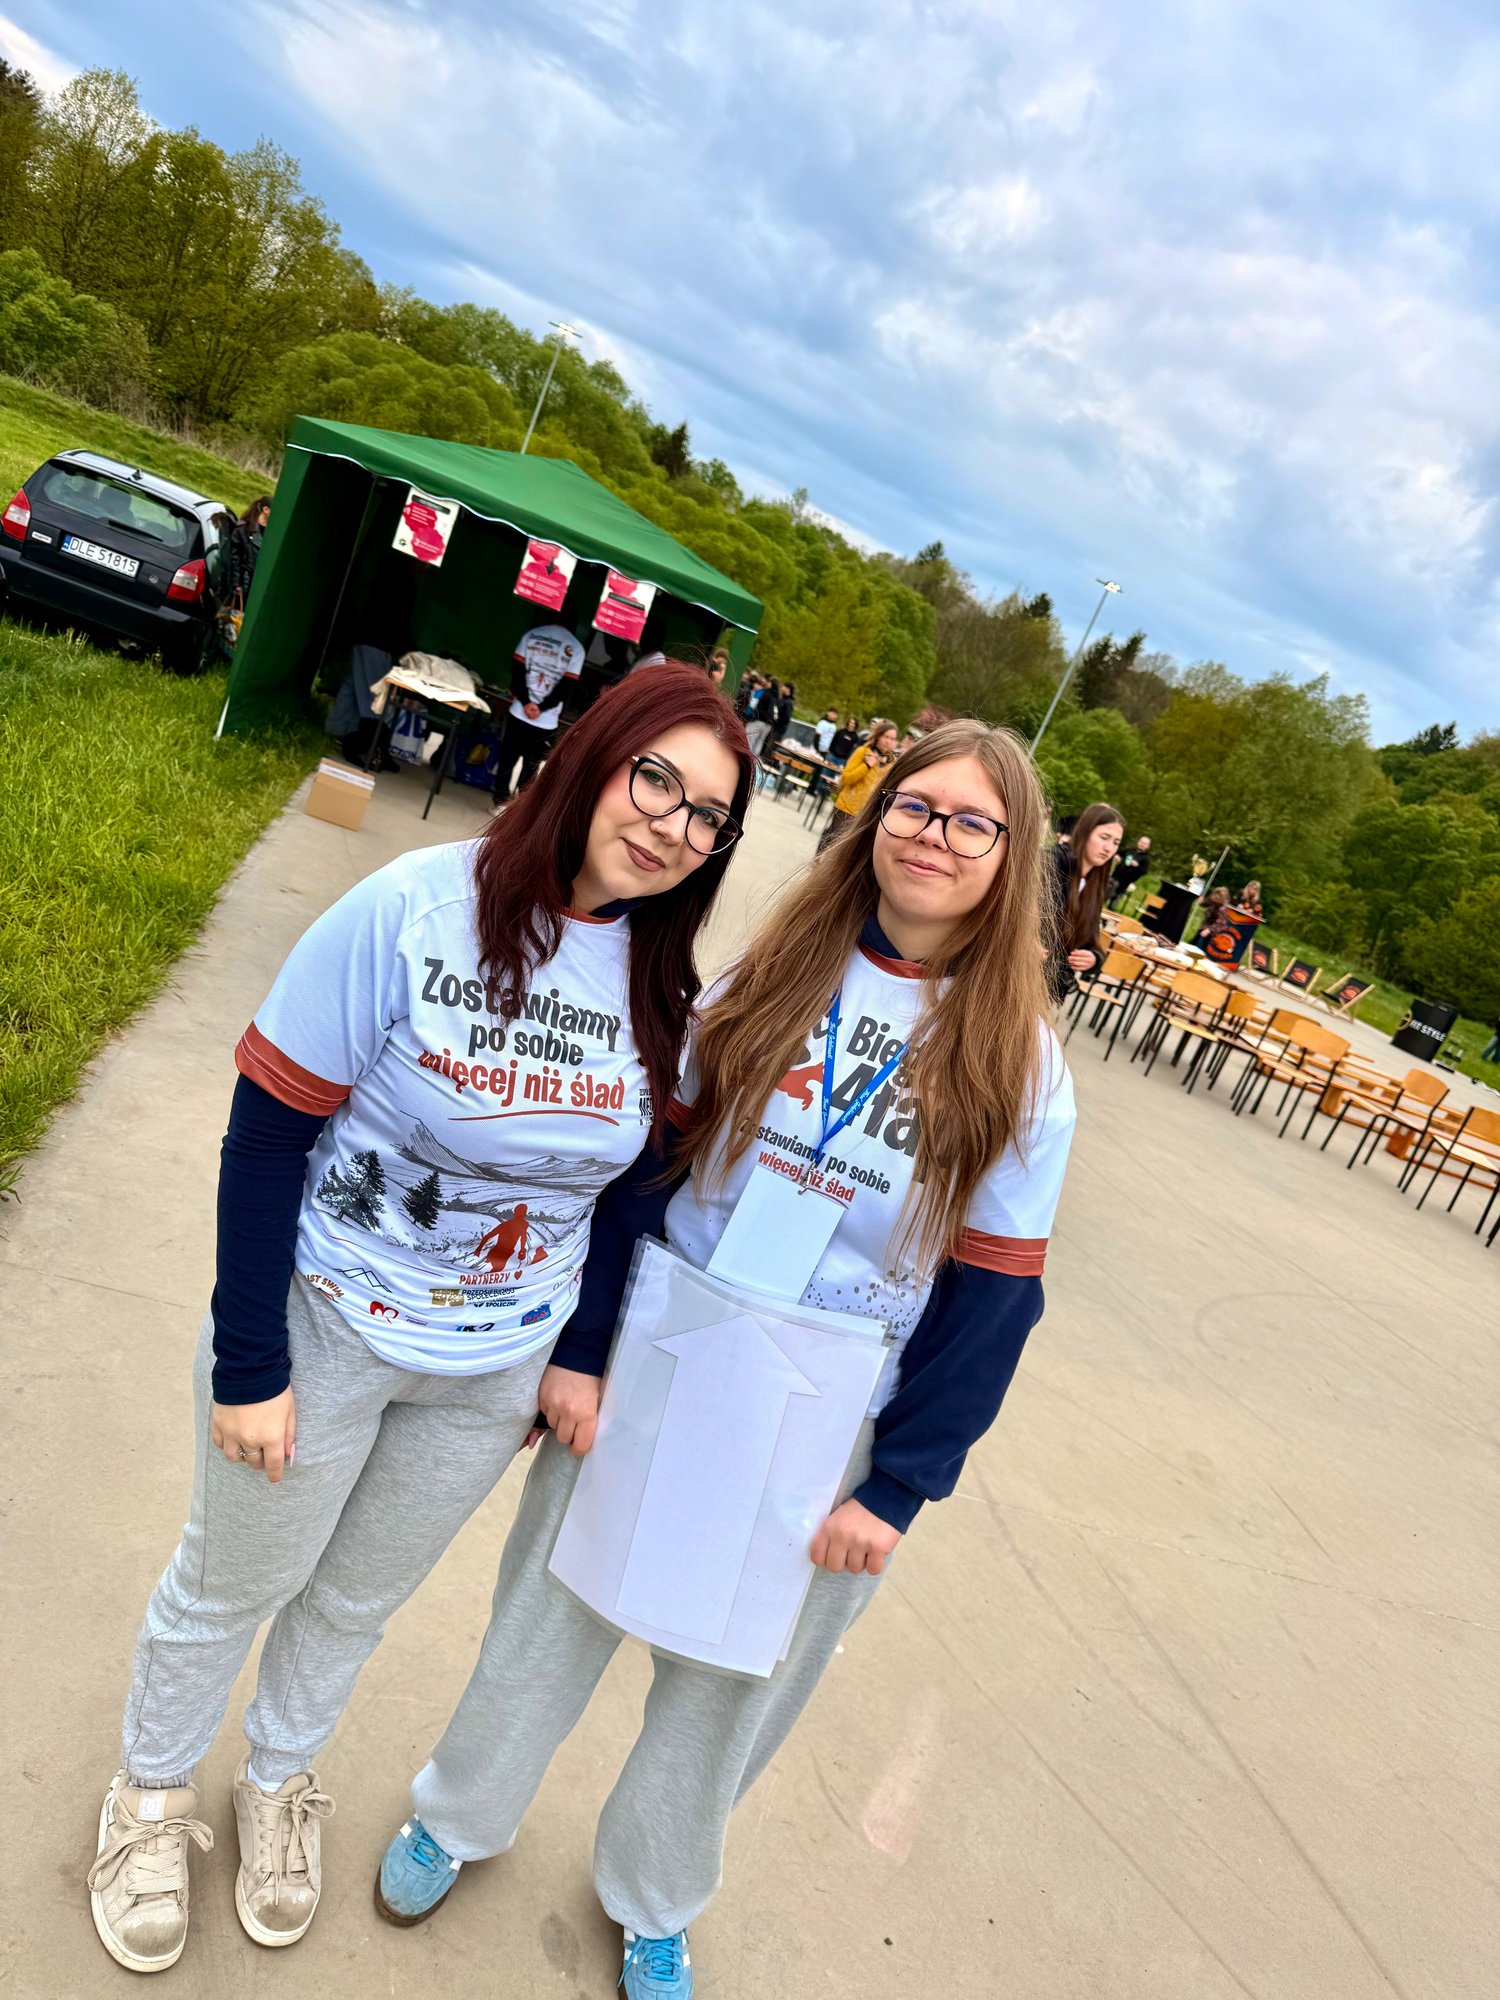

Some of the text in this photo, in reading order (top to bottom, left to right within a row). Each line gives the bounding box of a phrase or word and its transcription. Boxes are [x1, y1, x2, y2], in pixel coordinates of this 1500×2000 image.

[70, 538, 137, 573] DLE 51815
[421, 957, 621, 1052] Zostawiamy
[468, 1023, 584, 1065] po sobie
[1420, 1024, 1447, 1042] STYLE
[417, 1048, 518, 1107] więcej
[524, 1065, 563, 1104] niż
[570, 1071, 625, 1110] ślad
[758, 1151, 805, 1183] więcej
[825, 1177, 856, 1202] ślad
[825, 1156, 847, 1173] po
[849, 1166, 891, 1194] sobie
[459, 1271, 511, 1285] PARTNERZY
